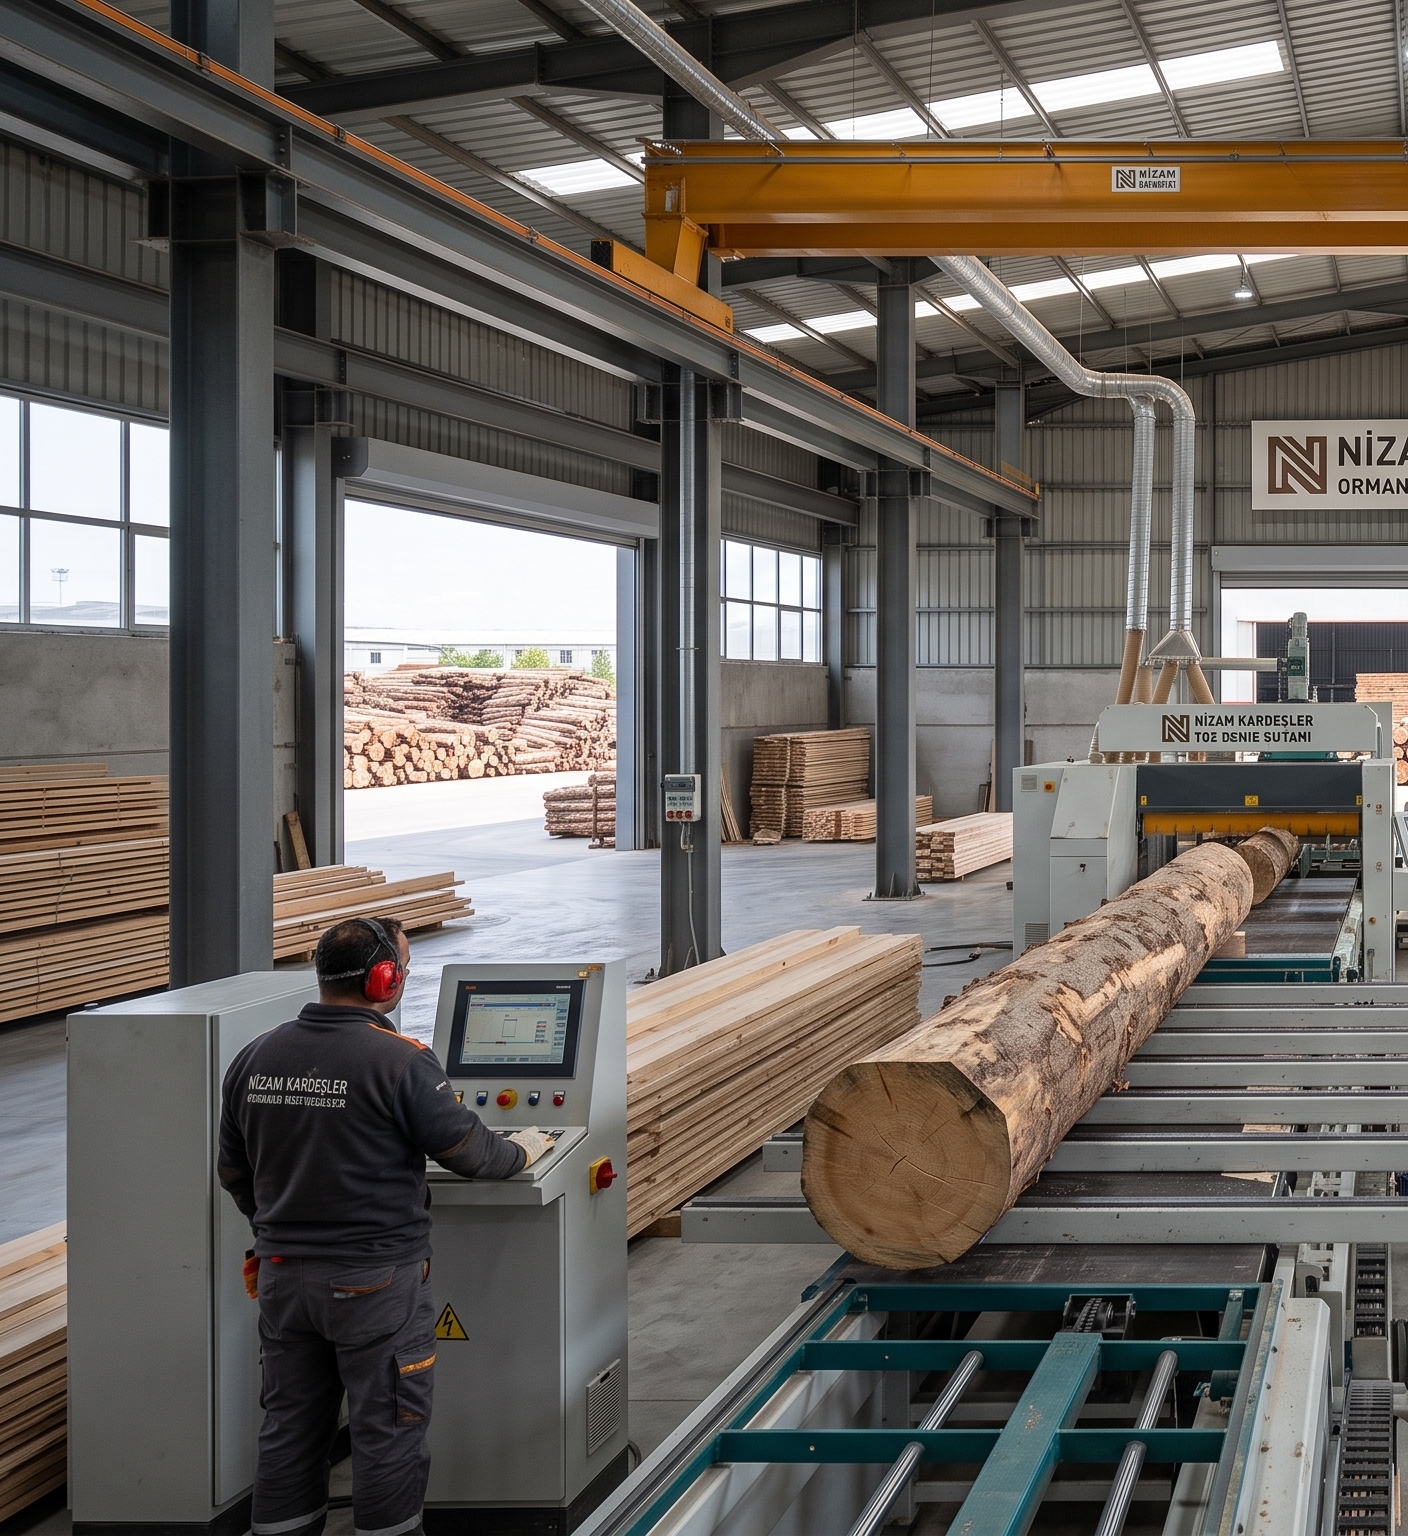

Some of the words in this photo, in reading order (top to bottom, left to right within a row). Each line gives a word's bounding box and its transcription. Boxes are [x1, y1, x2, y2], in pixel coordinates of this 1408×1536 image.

[1339, 478, 1408, 494] ORMAN
[1195, 713, 1234, 726] NİZAM
[1238, 714, 1314, 729] KARDEŞLER
[286, 1077, 348, 1096] KARDEŞLER
